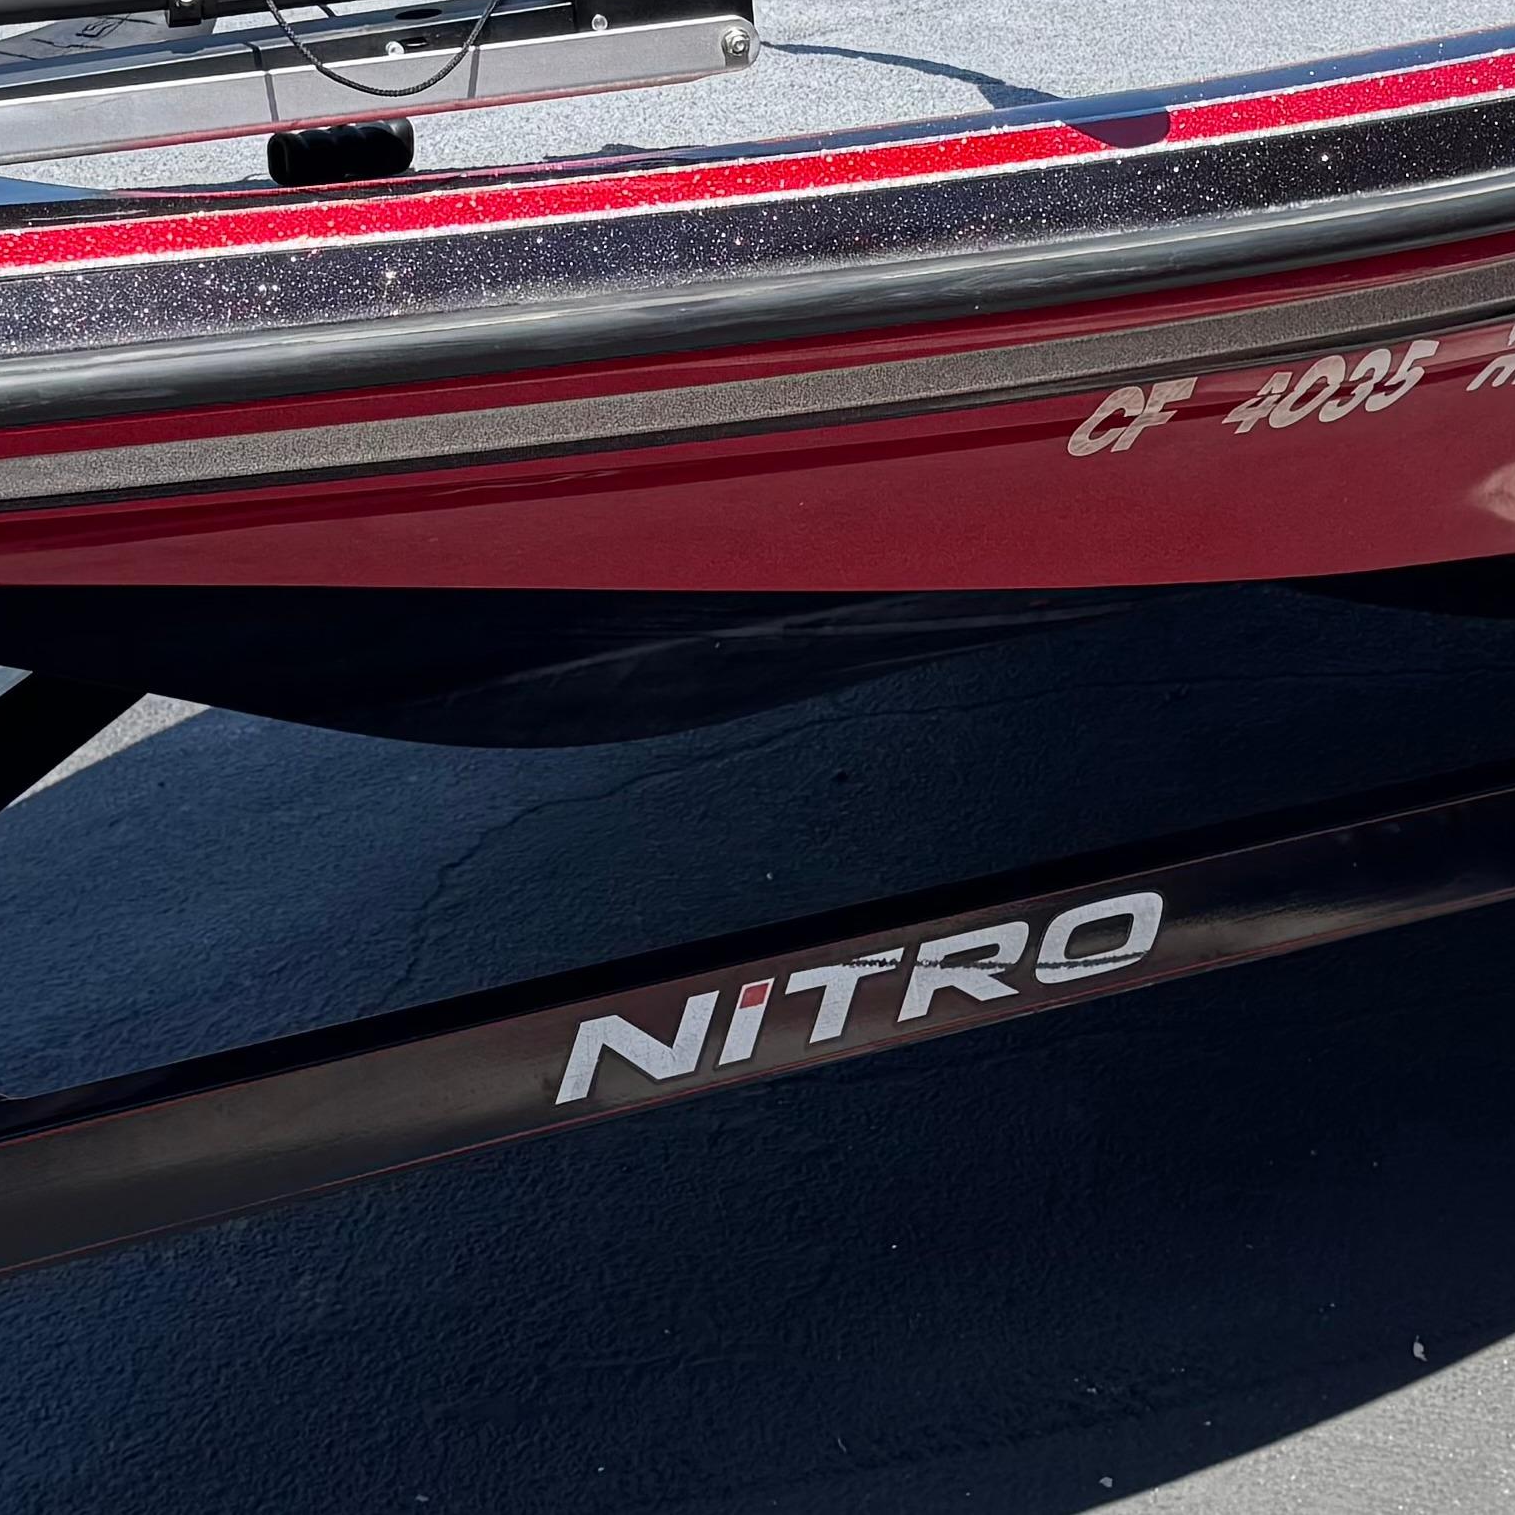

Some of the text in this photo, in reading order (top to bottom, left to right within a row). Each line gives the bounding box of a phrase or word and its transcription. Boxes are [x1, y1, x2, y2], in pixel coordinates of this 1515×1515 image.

[1067, 376, 1198, 457] CF
[1221, 338, 1440, 435] 4035
[554, 890, 1165, 1107] NITRO
